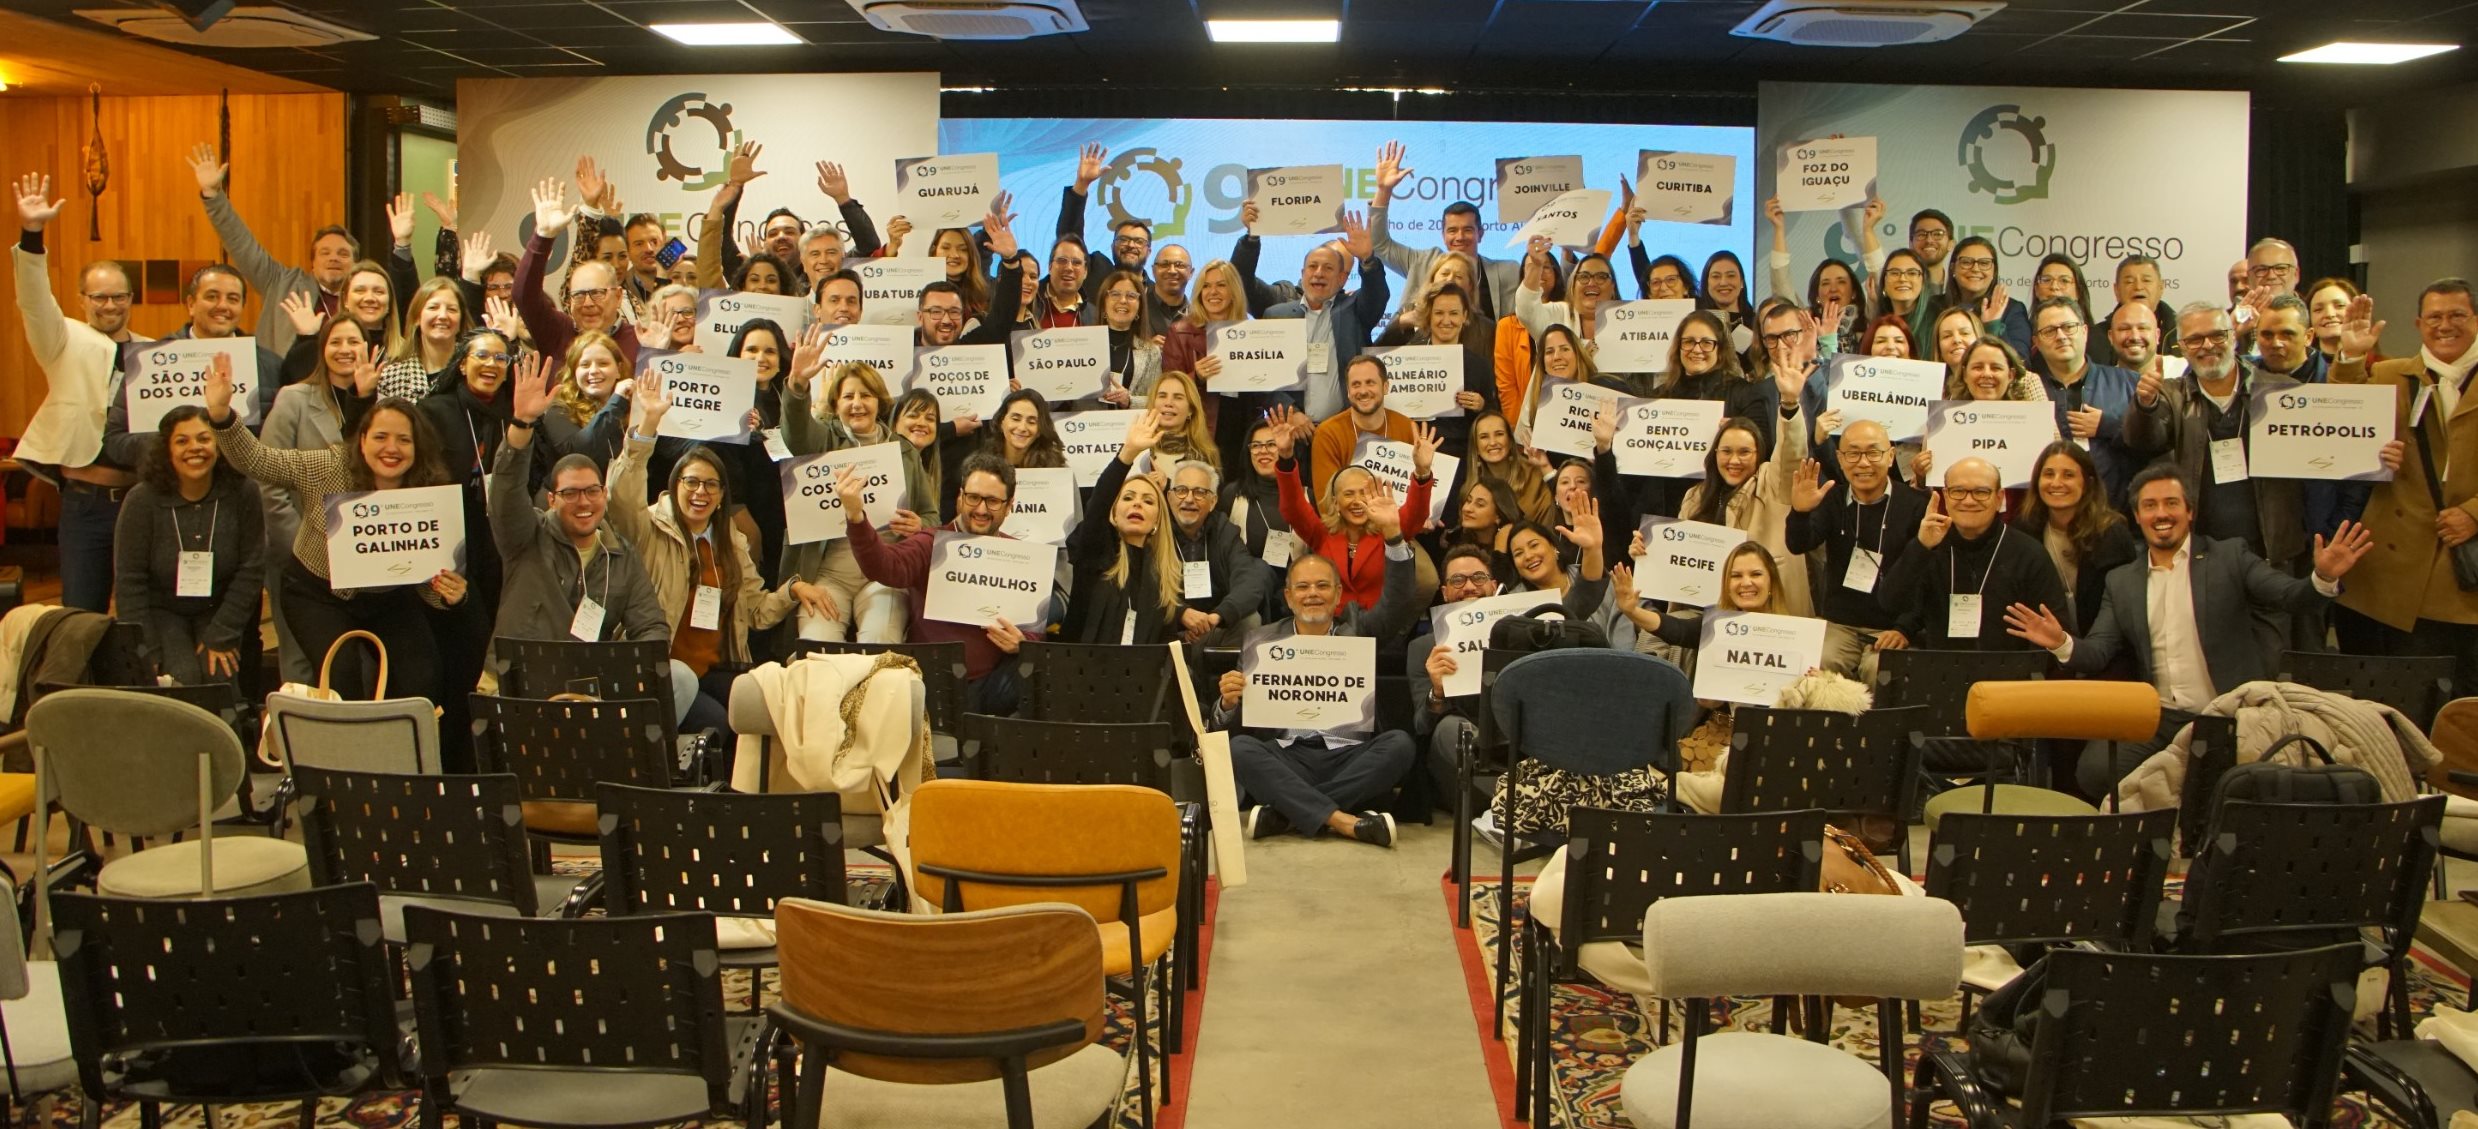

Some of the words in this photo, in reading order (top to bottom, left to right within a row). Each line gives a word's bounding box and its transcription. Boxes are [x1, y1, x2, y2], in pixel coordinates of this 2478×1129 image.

[1803, 164, 1827, 173] FOZ
[1831, 162, 1849, 171] DO
[1656, 181, 1712, 193] CURITIBA
[1802, 176, 1850, 187] IGUAÇU
[918, 183, 980, 198] GUARUJÁ
[1514, 183, 1570, 194] JOINVILLE
[1271, 194, 1321, 206] FLORIPA
[1408, 219, 1424, 231] de
[1481, 220, 1507, 231] orto
[864, 289, 922, 299] UBATUBA
[1620, 332, 1669, 341] ATIBAIA
[1229, 349, 1284, 361] BRASÍLIA
[1029, 358, 1053, 370] SÃO
[1057, 358, 1096, 369] PAULO
[151, 370, 185, 385] SÃO
[929, 372, 971, 384] POÇOS
[974, 371, 990, 380] DE
[1387, 368, 1448, 381] ALNEÁRIO
[140, 387, 174, 400] DOS
[669, 380, 721, 395] PORTO
[936, 385, 985, 396] CALDAS
[1390, 382, 1446, 394] AMBORIÚ
[1842, 389, 1928, 408] UBERLÂNDIA
[1560, 418, 1593, 433] JANE
[1646, 425, 1689, 437] BENTO
[2268, 420, 2376, 439] PETRÓPOLIS
[1063, 442, 1126, 455] ORTALEZ
[1626, 438, 1707, 452] GONÇALVES
[1972, 438, 2007, 450] PIPA
[819, 492, 876, 511] COIS
[1011, 500, 1047, 514] IÂNIA
[352, 521, 413, 537] PORTO
[417, 520, 440, 532] DE
[355, 537, 440, 554] GALINHAS
[1669, 554, 1715, 572] RECIFE
[945, 570, 1038, 593] GUARULHOS
[1726, 649, 1787, 669] NATAL
[1252, 673, 1340, 688] FERNANDO
[1344, 675, 1365, 689] DE
[1268, 689, 1348, 703] NORONHA
